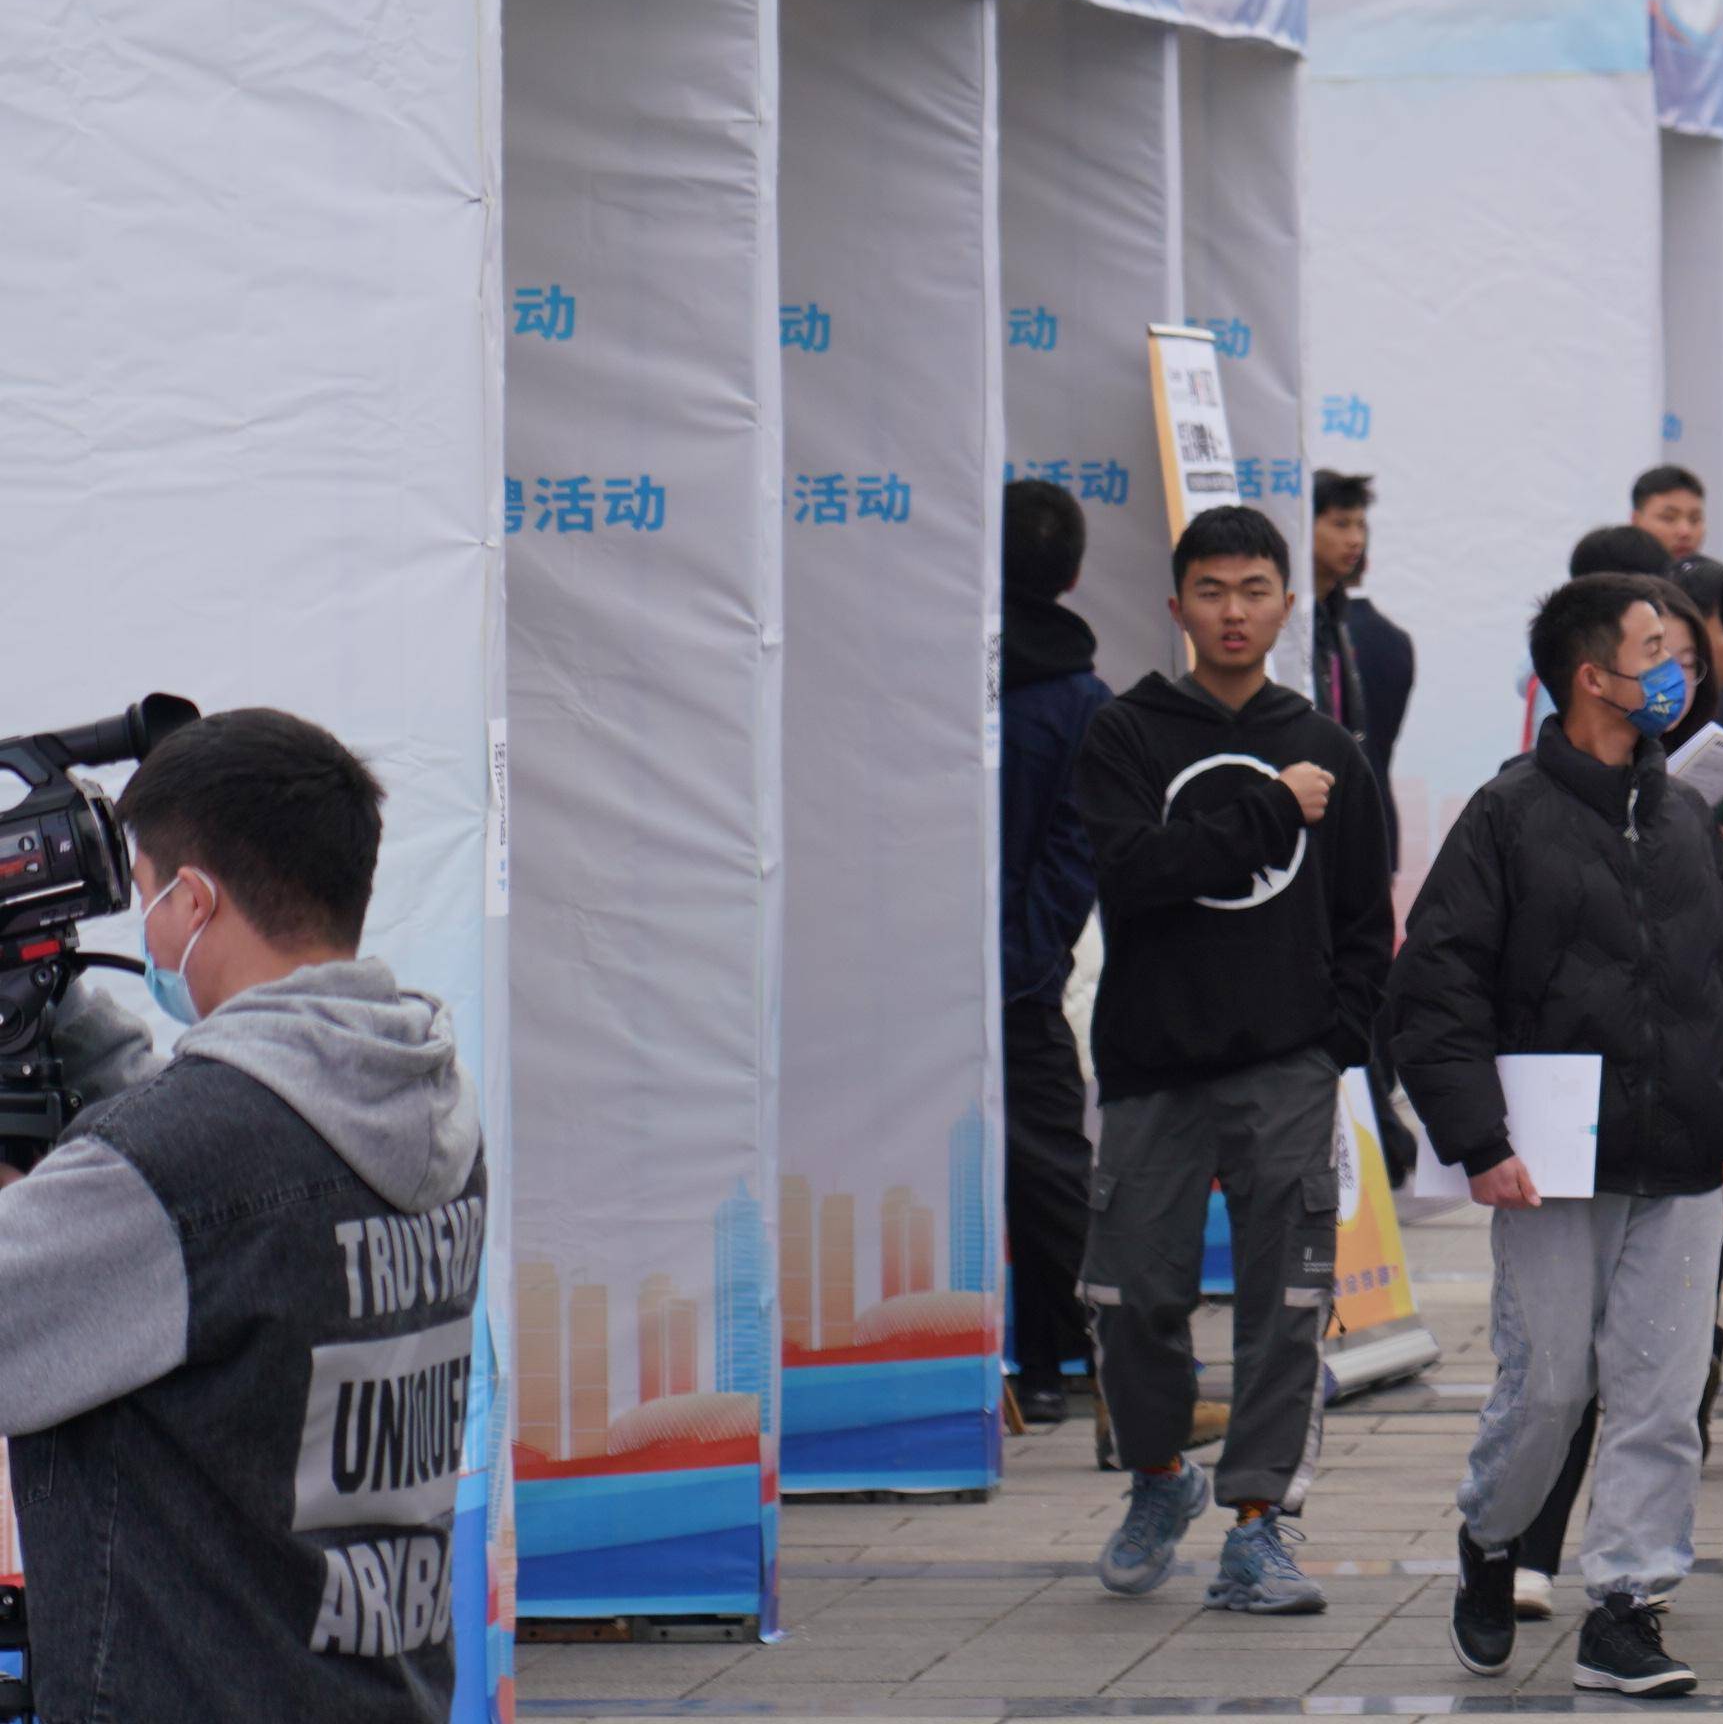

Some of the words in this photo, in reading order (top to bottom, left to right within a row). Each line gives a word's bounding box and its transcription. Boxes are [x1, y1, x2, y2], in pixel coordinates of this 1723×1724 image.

[513, 284, 576, 340] 动
[780, 303, 830, 353] 动
[1008, 305, 1058, 351] 动
[1322, 395, 1371, 440] 动
[793, 472, 911, 525] 活动
